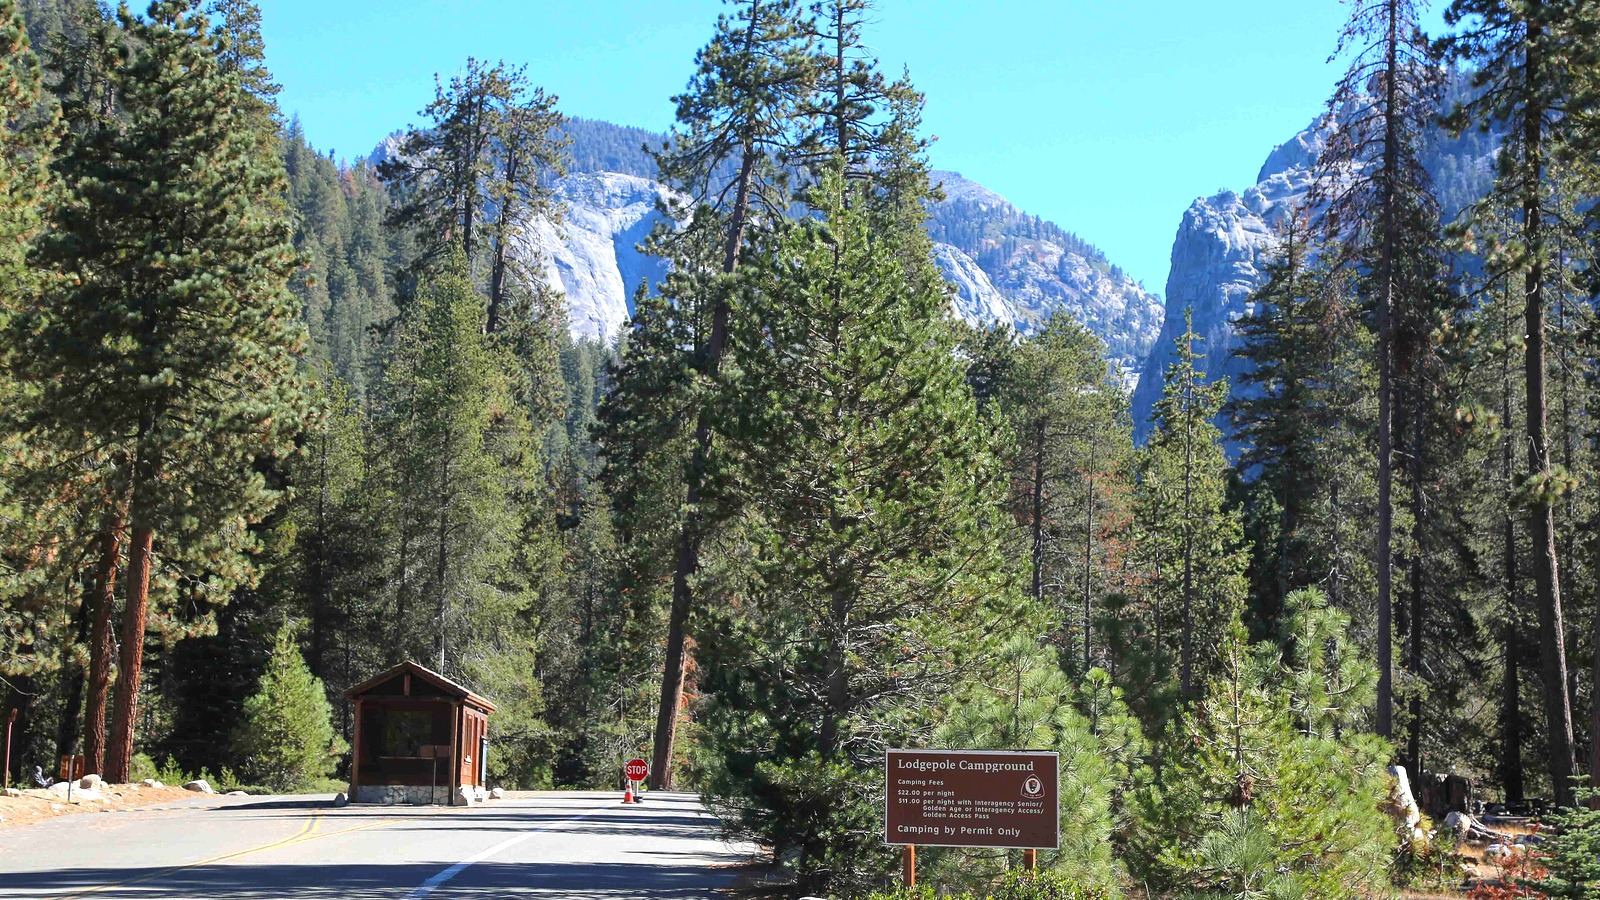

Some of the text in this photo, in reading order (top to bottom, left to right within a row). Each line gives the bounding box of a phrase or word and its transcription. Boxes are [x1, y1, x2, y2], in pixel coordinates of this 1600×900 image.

[627, 766, 646, 774] STOP
[898, 760, 1034, 772] Lodgepole Campground
[898, 825, 939, 834] Camping
[998, 828, 1020, 837] Only
